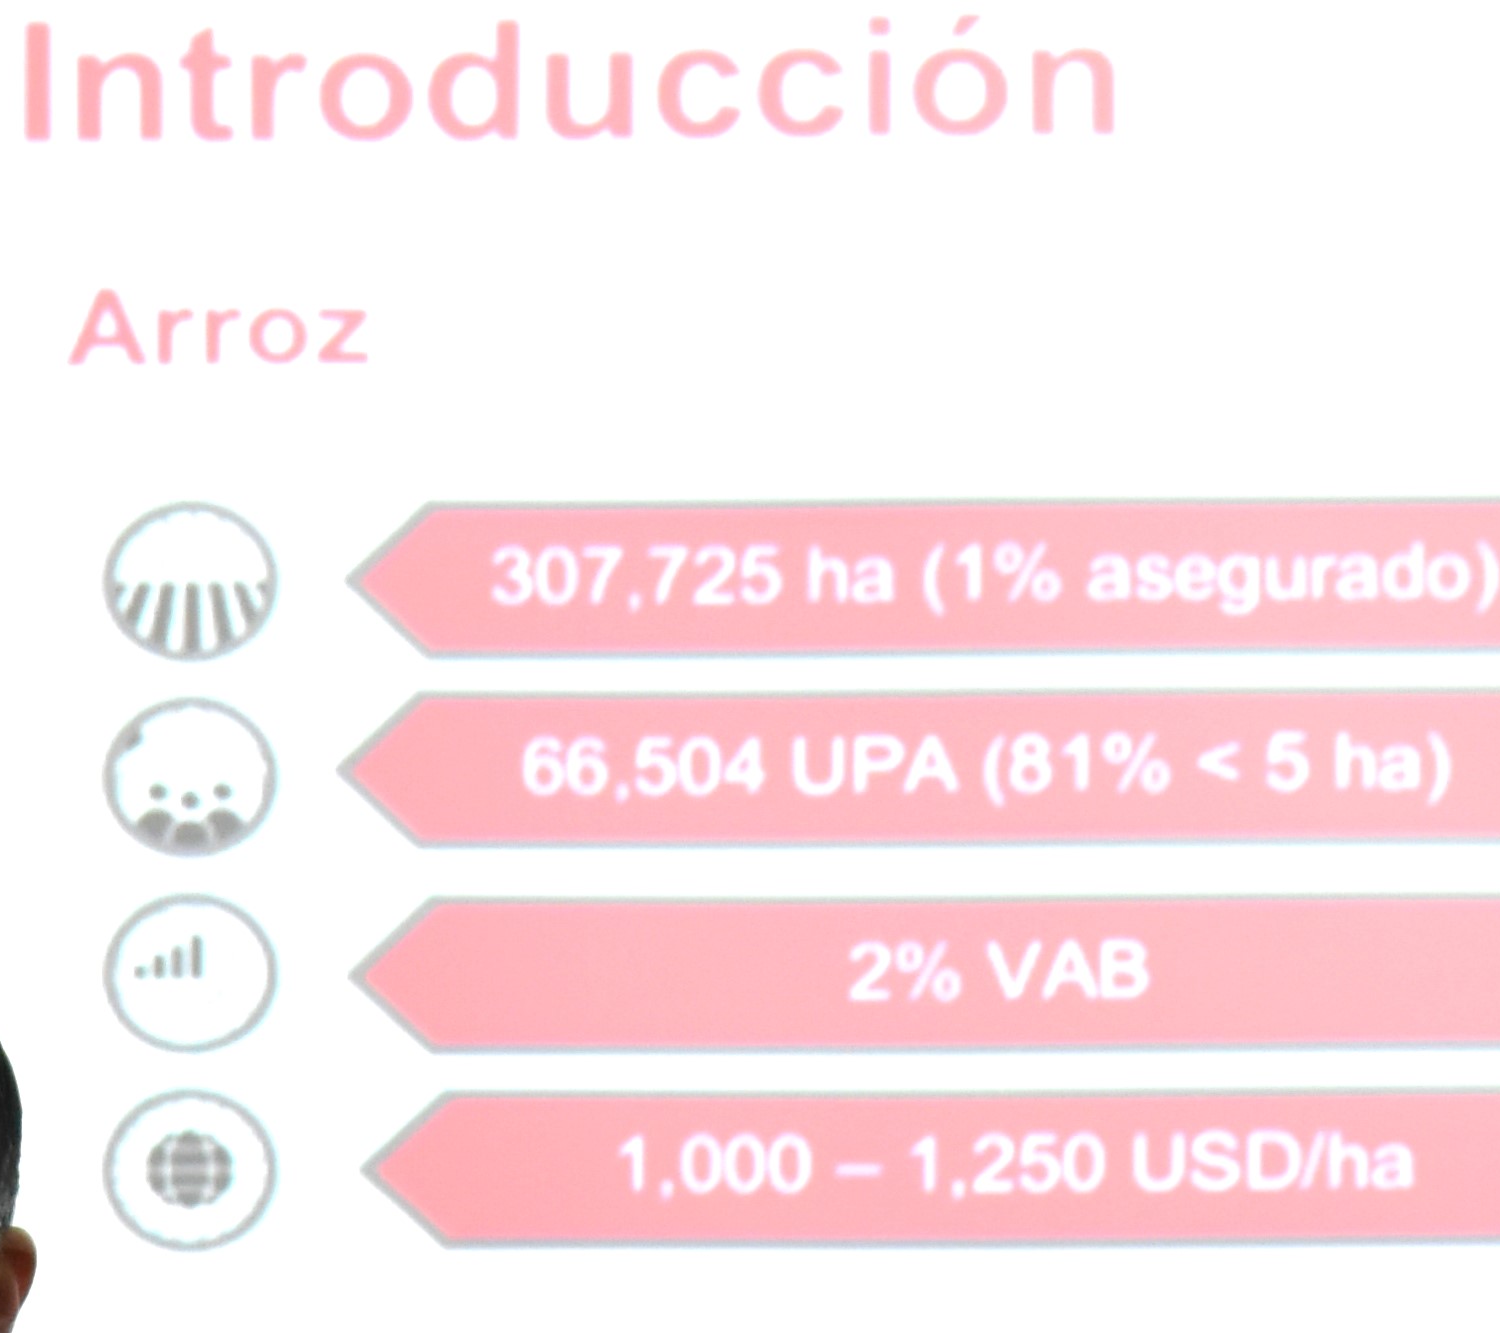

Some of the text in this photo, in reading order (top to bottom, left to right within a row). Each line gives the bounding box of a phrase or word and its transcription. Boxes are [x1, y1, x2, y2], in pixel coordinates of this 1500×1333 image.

[24, 14, 1115, 142] Introducción
[68, 288, 368, 366] Arroz
[491, 544, 784, 612] 307,725
[807, 545, 896, 605] ha
[922, 541, 1063, 616] (1%
[521, 729, 1453, 807] 66,504 UPA (81% < 5 ha)
[848, 937, 1151, 1003] 2% VAB
[619, 1132, 814, 1198] 1,000
[911, 1131, 1107, 1199] 1,250
[1132, 1128, 1415, 1194] USD/ha
